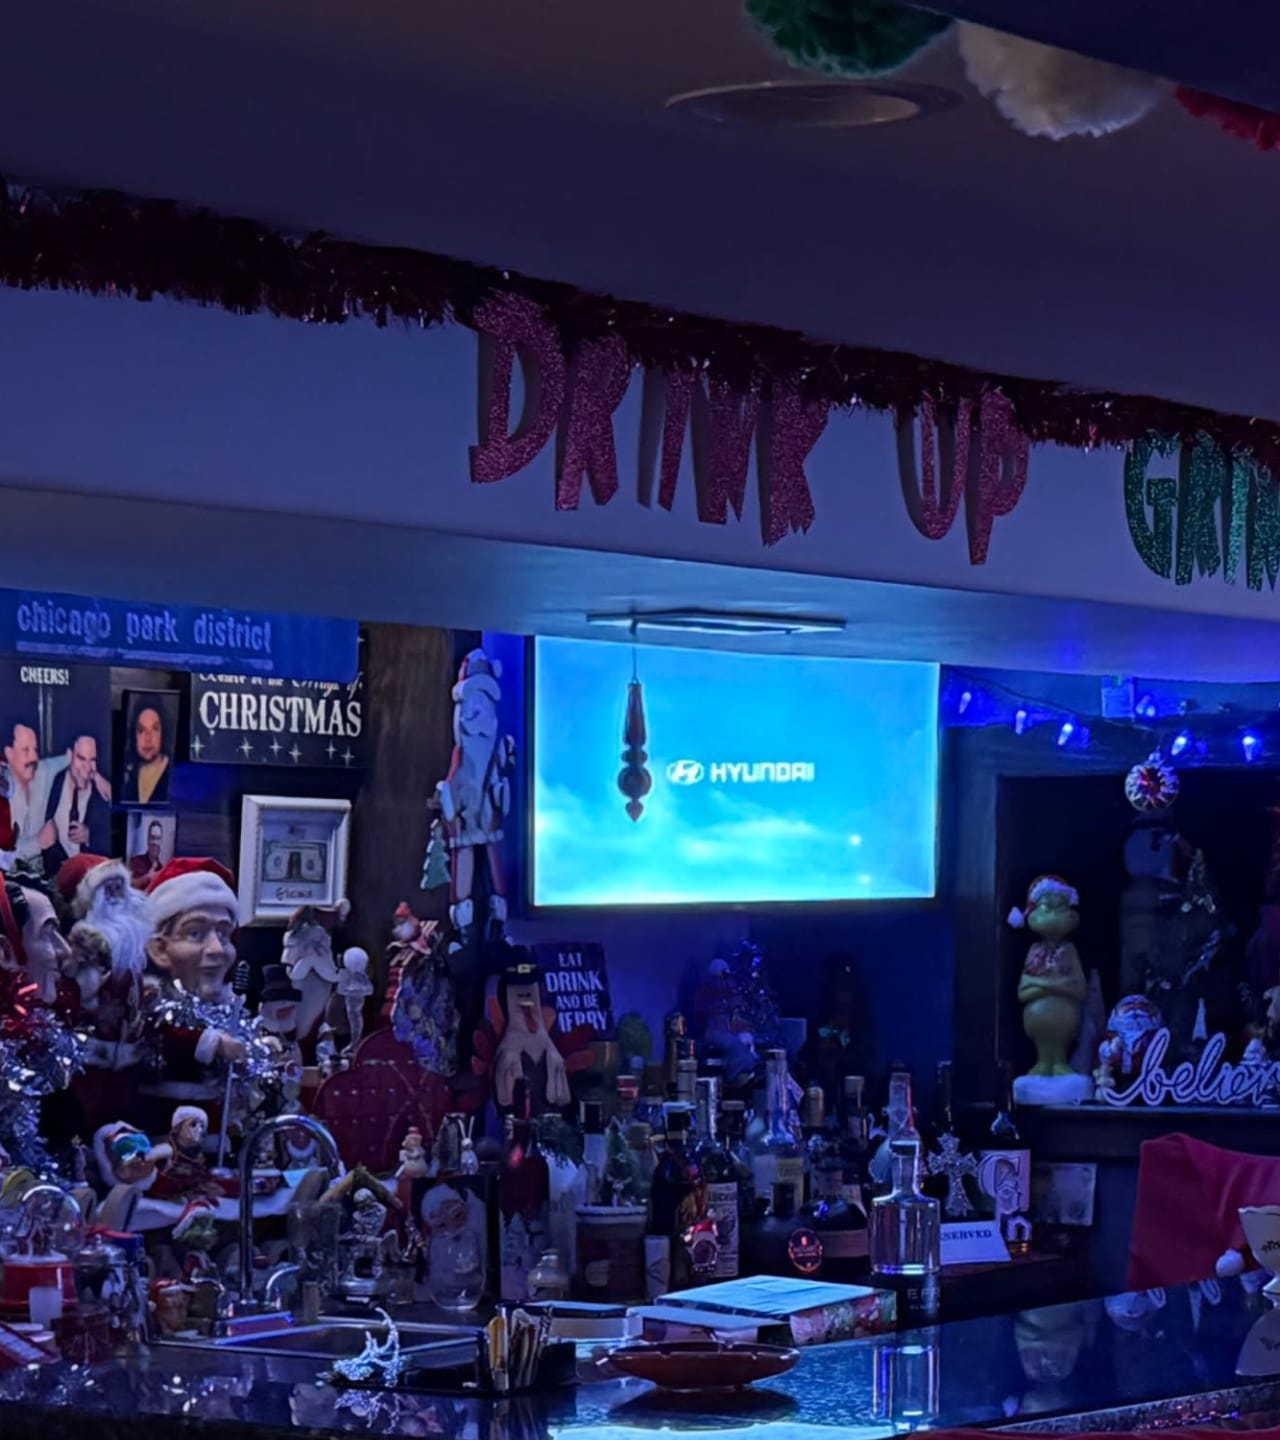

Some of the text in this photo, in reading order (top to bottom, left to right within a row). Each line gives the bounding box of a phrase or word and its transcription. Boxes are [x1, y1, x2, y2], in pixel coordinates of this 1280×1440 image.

[469, 292, 829, 547] DRINK
[922, 382, 1029, 565] UP
[17, 600, 272, 655] chicago park district
[20, 666, 70, 687] CHEERS!
[199, 690, 363, 738] CHRISTMAS
[710, 762, 816, 783] HYUNDAI
[558, 951, 584, 968] EAT
[544, 970, 605, 993] DRINK
[555, 993, 601, 1010] AND BE
[940, 1229, 992, 1241] SERVED
